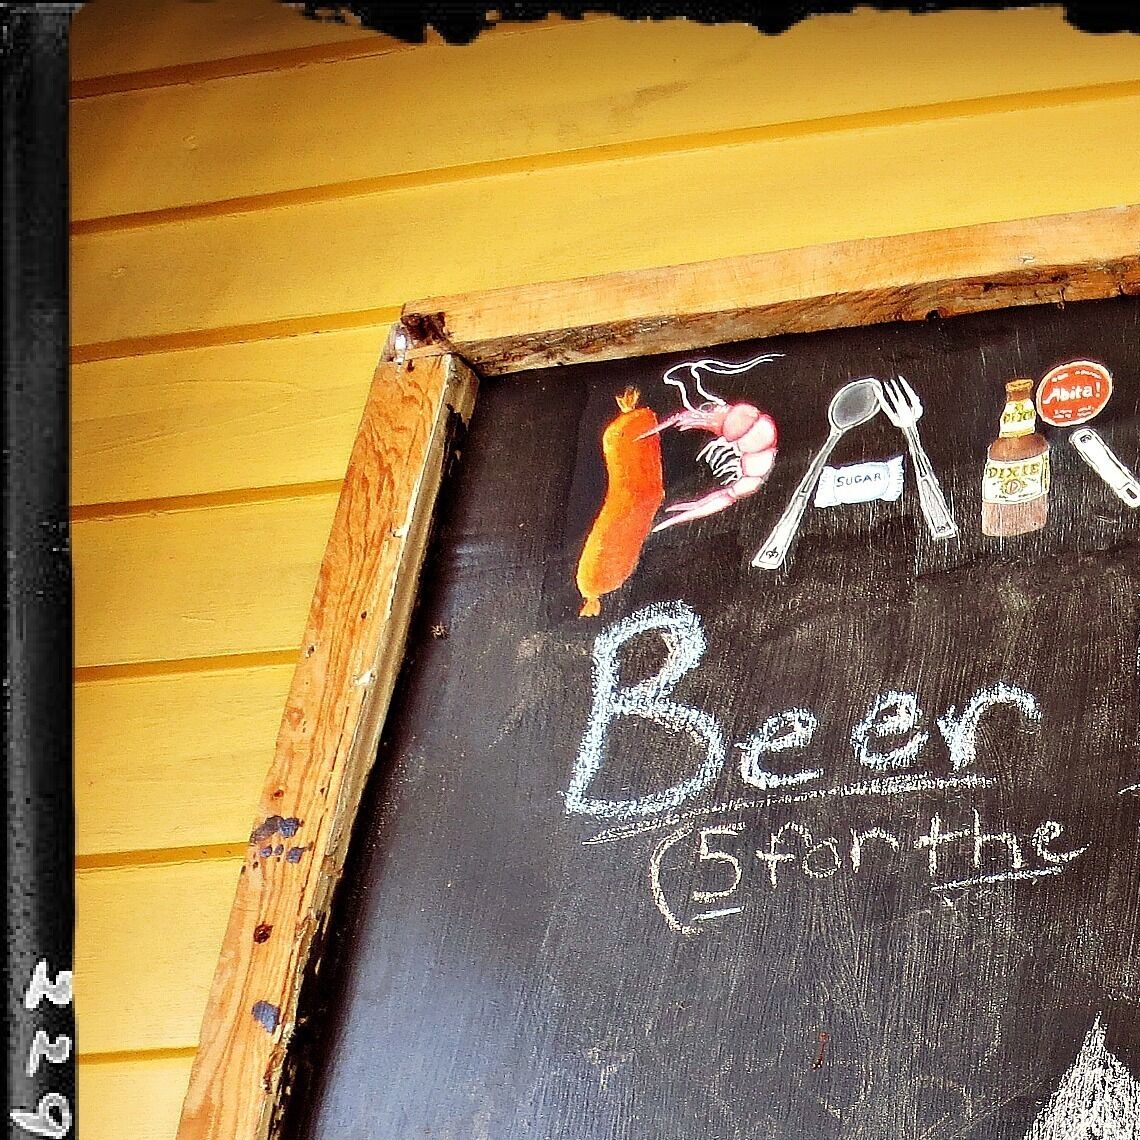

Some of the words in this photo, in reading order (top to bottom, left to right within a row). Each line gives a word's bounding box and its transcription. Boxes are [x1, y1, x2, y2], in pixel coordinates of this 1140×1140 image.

[836, 473, 882, 487] SUGAR
[988, 462, 1040, 478] DIXIE
[565, 601, 1041, 816] Beer
[914, 810, 1088, 873] the
